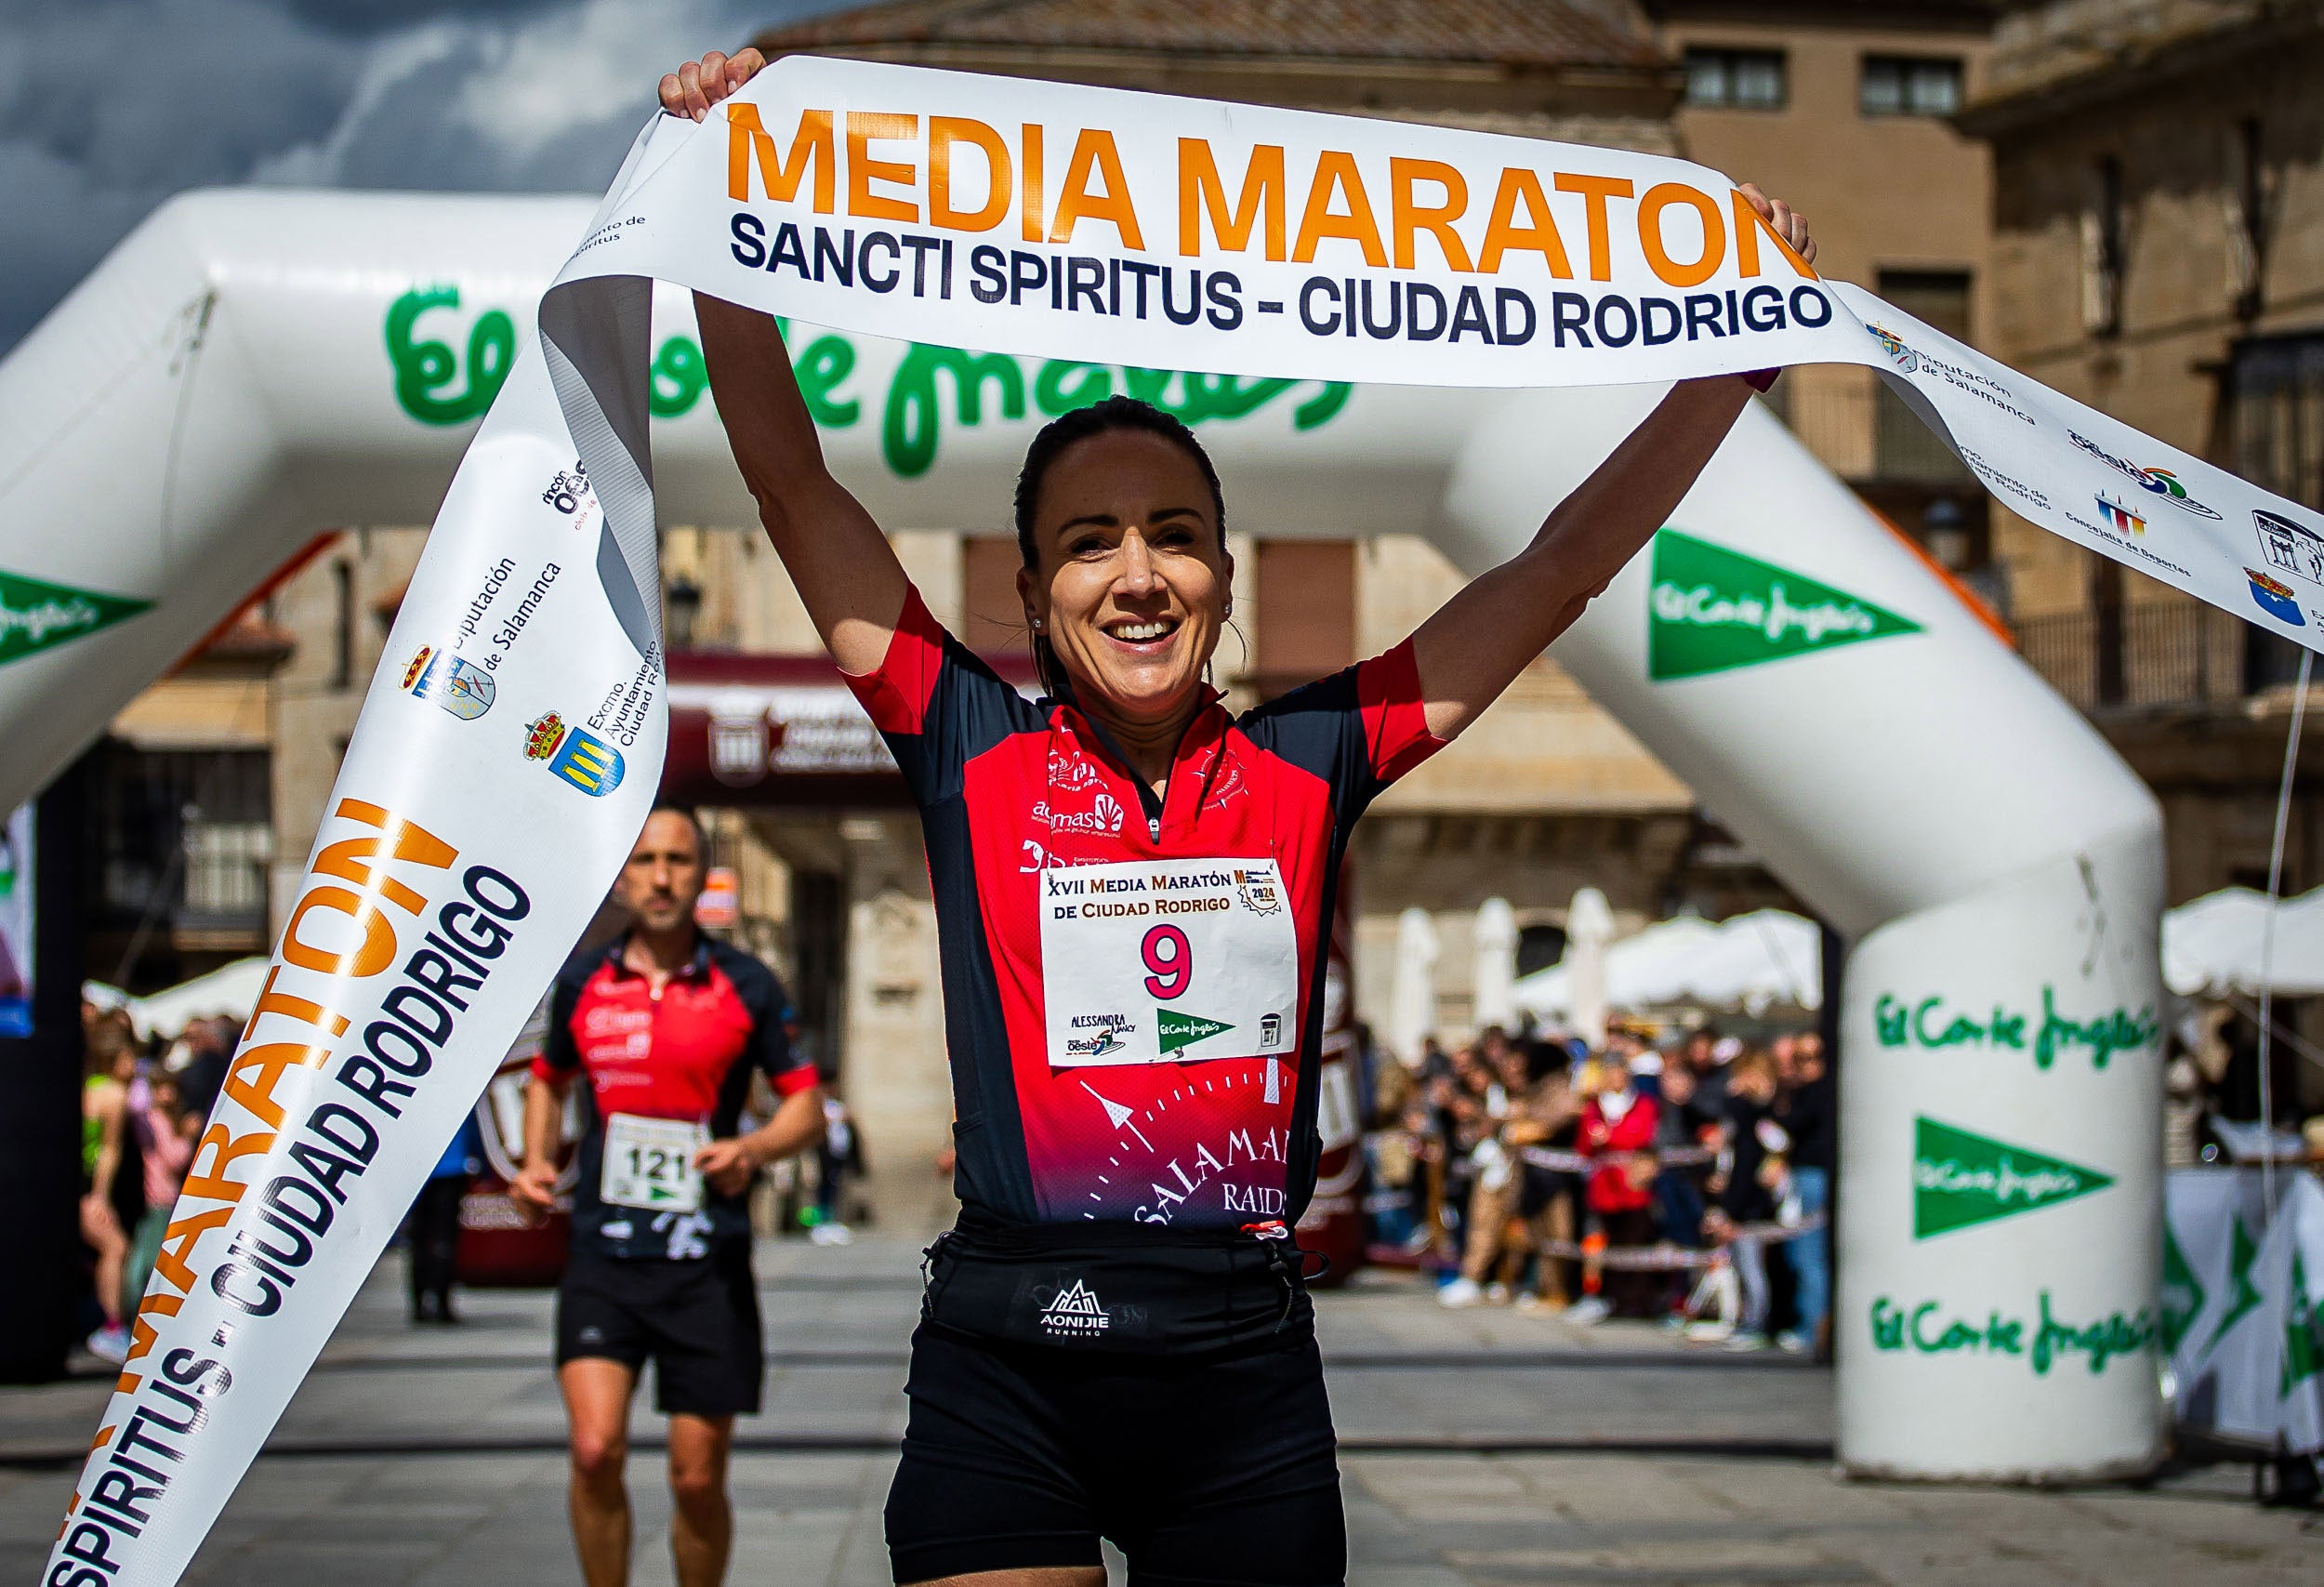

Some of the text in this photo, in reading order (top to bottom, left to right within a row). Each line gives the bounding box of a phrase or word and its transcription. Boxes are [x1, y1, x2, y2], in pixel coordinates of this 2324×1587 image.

[727, 102, 1820, 287] MEDIA MARATON
[626, 217, 646, 226] de
[730, 212, 952, 300] SANCTI
[971, 244, 1243, 331] SPIRITUS
[1300, 276, 1537, 347] CIUDAD
[1552, 284, 1833, 348] RODRIGO
[1921, 364, 2037, 426] de Salamanca
[542, 469, 570, 505] rincón
[2031, 489, 2049, 502] de
[2125, 541, 2139, 552] de
[2141, 548, 2192, 577] Deportes
[484, 562, 561, 671] de Salamanca
[587, 681, 627, 731] Excmo.
[604, 641, 656, 740] Ayuntamiento
[620, 690, 653, 747] Ciudad
[1048, 879, 1085, 896] XVII
[1251, 887, 1275, 898] 2024
[1054, 906, 1077, 919] DE
[1141, 923, 1193, 1001] 9
[1071, 1013, 1126, 1028] ALESSANDRA
[1159, 1020, 1220, 1036] El Corte Inglés
[627, 1144, 686, 1183] 121
[1221, 1183, 1287, 1216] RAID
[46, 1347, 232, 1587] SPIRITUS
[210, 1103, 379, 1317] CIUDAD
[336, 864, 532, 1120] RODRIGO
[1040, 1315, 1109, 1329] AONIJIE
[1046, 1328, 1101, 1337] RUNNING
